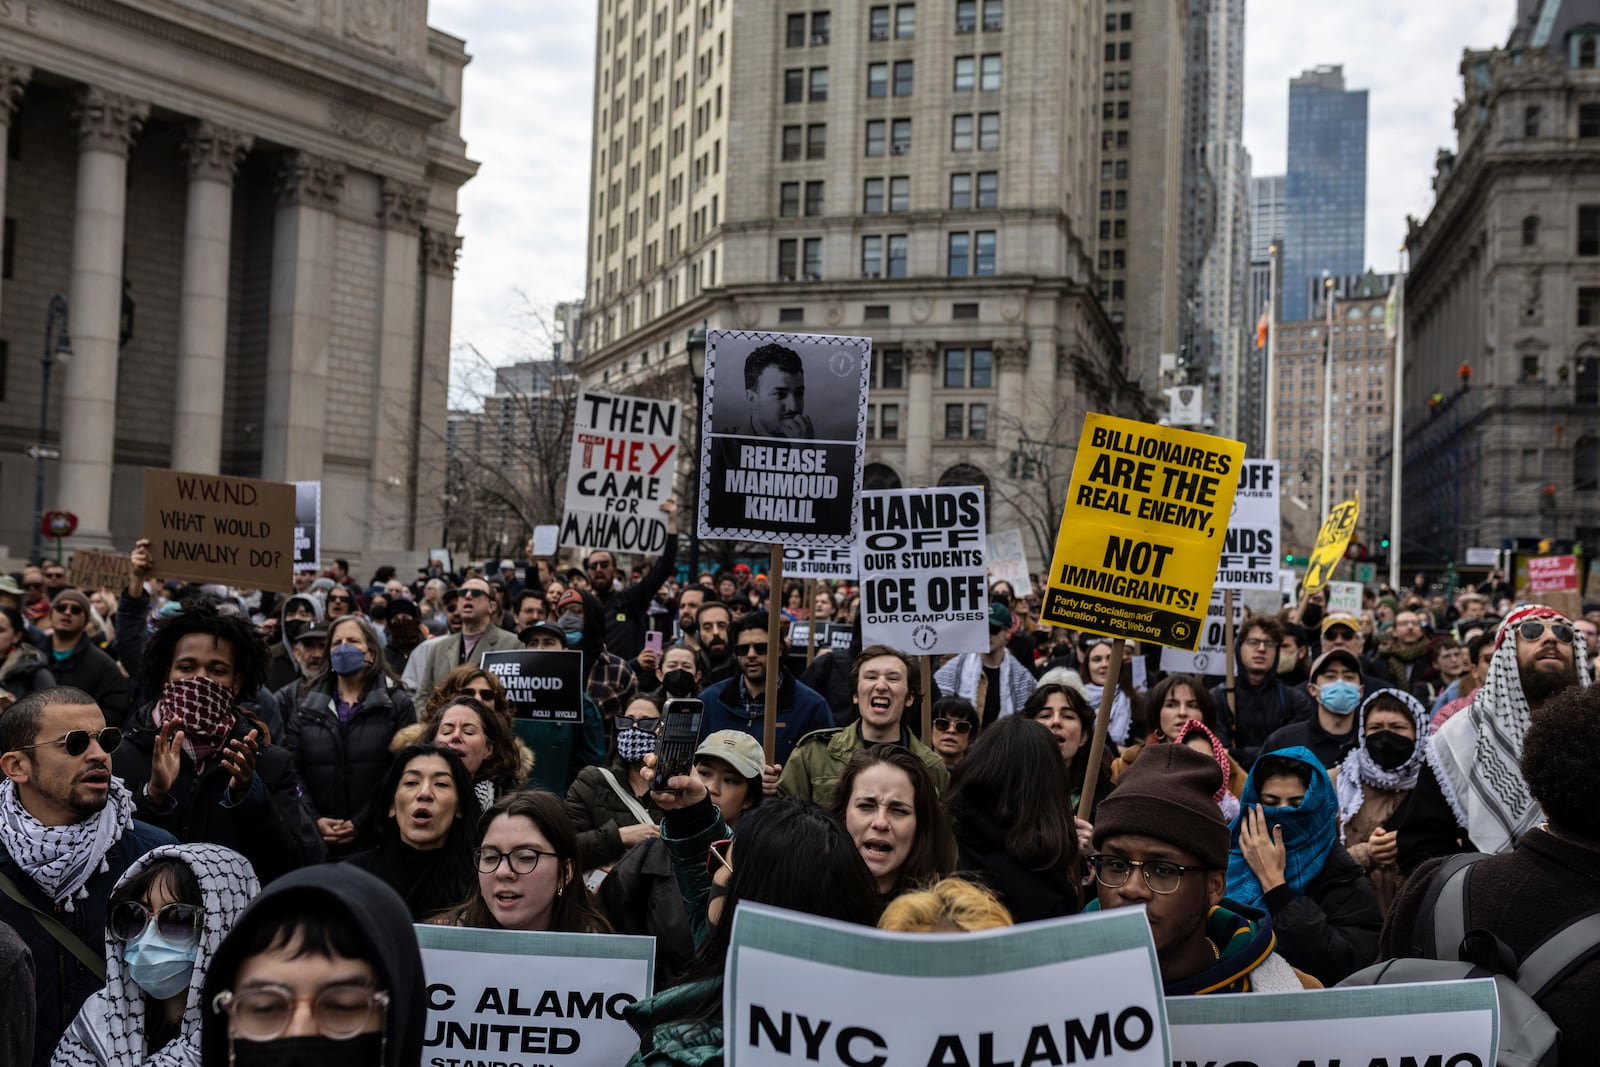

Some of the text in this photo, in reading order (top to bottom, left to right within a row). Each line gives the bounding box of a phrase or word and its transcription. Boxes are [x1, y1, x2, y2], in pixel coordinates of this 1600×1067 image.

[577, 433, 676, 476] THEY
[740, 445, 827, 473] RELEASE
[1091, 427, 1232, 475] BILLIONAIRES
[577, 470, 660, 501] CAME
[724, 469, 839, 499] MAHMOUD
[1088, 454, 1220, 508] ARE THE
[1236, 490, 1273, 498] PUSES
[605, 498, 640, 514] FOR
[745, 496, 816, 524] KHALIL
[861, 492, 980, 531] HANDS
[1076, 485, 1215, 538] REAL ENEMY,
[160, 509, 271, 539] WHAT WOULD
[560, 512, 667, 552] MAHMOUD
[163, 540, 281, 569] NAVALNY DO?
[783, 548, 850, 561] OFF
[865, 529, 979, 551] OFF
[1222, 528, 1273, 555] NDS
[784, 561, 852, 574] UR STUDENTS
[864, 550, 983, 571] OUR STUDENTS
[1103, 536, 1174, 578] NOT
[1220, 555, 1271, 569] FF
[866, 578, 917, 614] ICE
[927, 575, 984, 612] OFF
[1060, 564, 1199, 611] IMMIGRANTS!
[867, 612, 984, 624] OUR CAMPUSES
[1052, 606, 1161, 637] Liberation PSLWeb.org
[1054, 595, 1153, 622] Party for Socialism and
[489, 663, 520, 676] FREE
[500, 676, 563, 690] AHMOUD
[505, 690, 536, 702] ALIL
[475, 987, 638, 1020] ALAMO
[422, 1020, 581, 1055] UNITED
[749, 1003, 1154, 1067] NYC ALAMO
